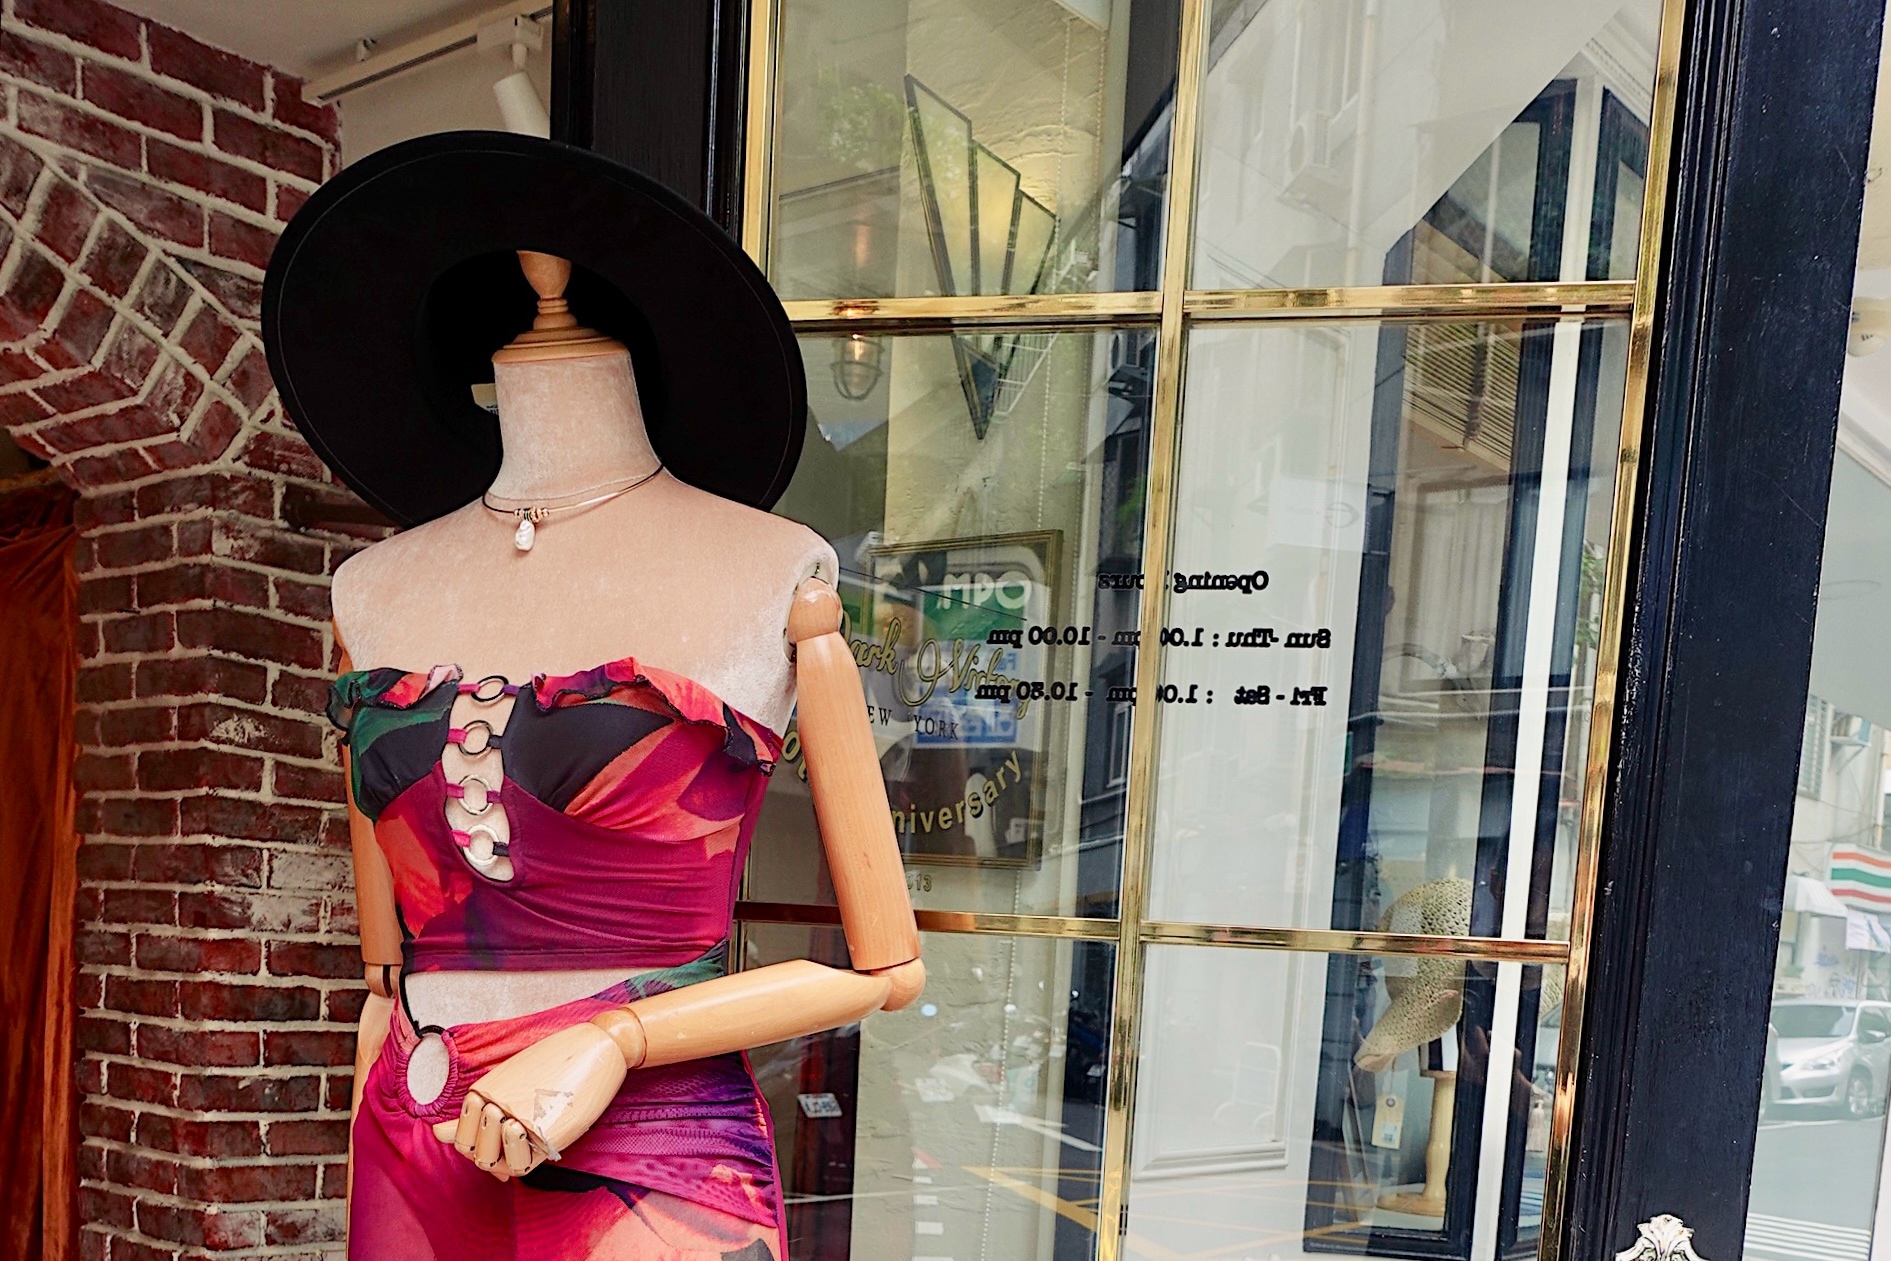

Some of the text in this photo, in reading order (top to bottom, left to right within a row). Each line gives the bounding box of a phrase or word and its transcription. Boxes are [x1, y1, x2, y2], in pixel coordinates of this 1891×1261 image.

[866, 705, 960, 741] EW YORK
[891, 749, 1022, 835] niversary
